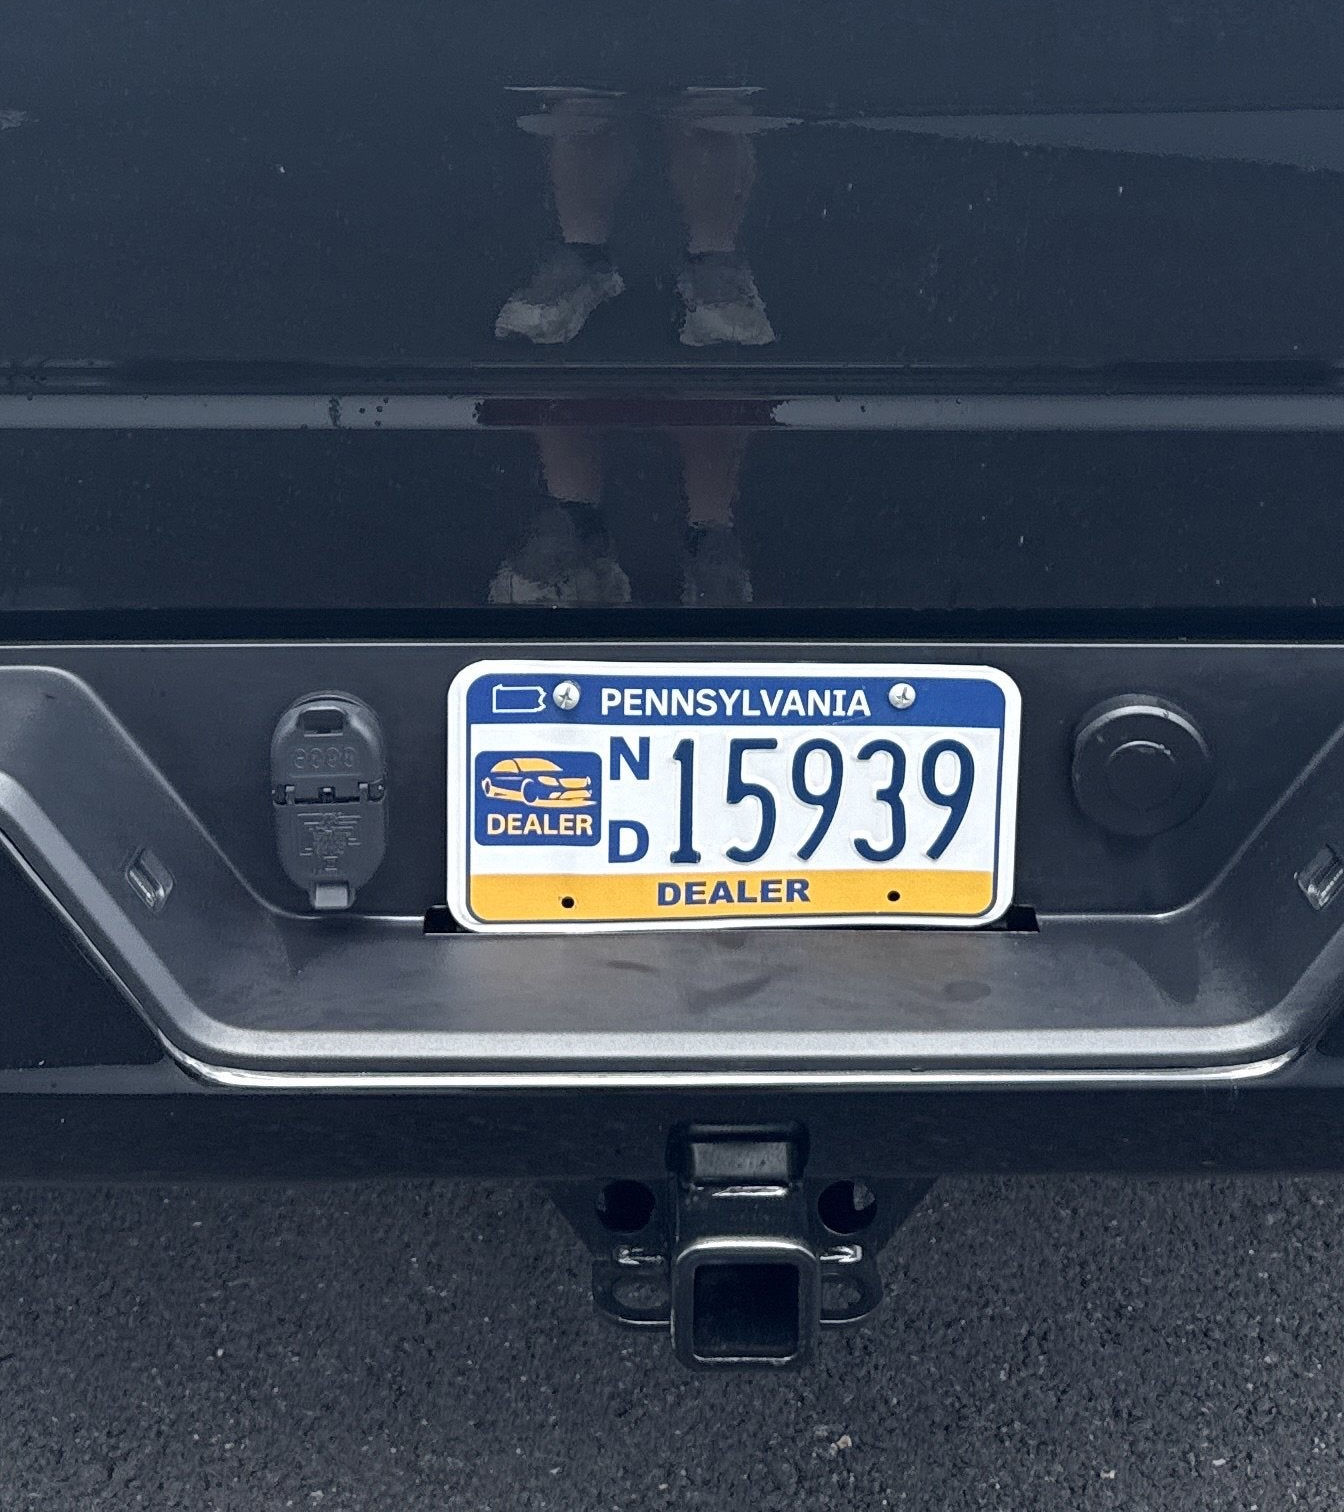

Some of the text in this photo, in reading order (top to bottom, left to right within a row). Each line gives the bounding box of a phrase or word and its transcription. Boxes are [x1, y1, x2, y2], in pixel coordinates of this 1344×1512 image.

[600, 687, 872, 718] PENNSYLVANIA
[670, 737, 976, 865] 15939
[485, 813, 594, 837] DEALER
[656, 877, 811, 907] DEALER
